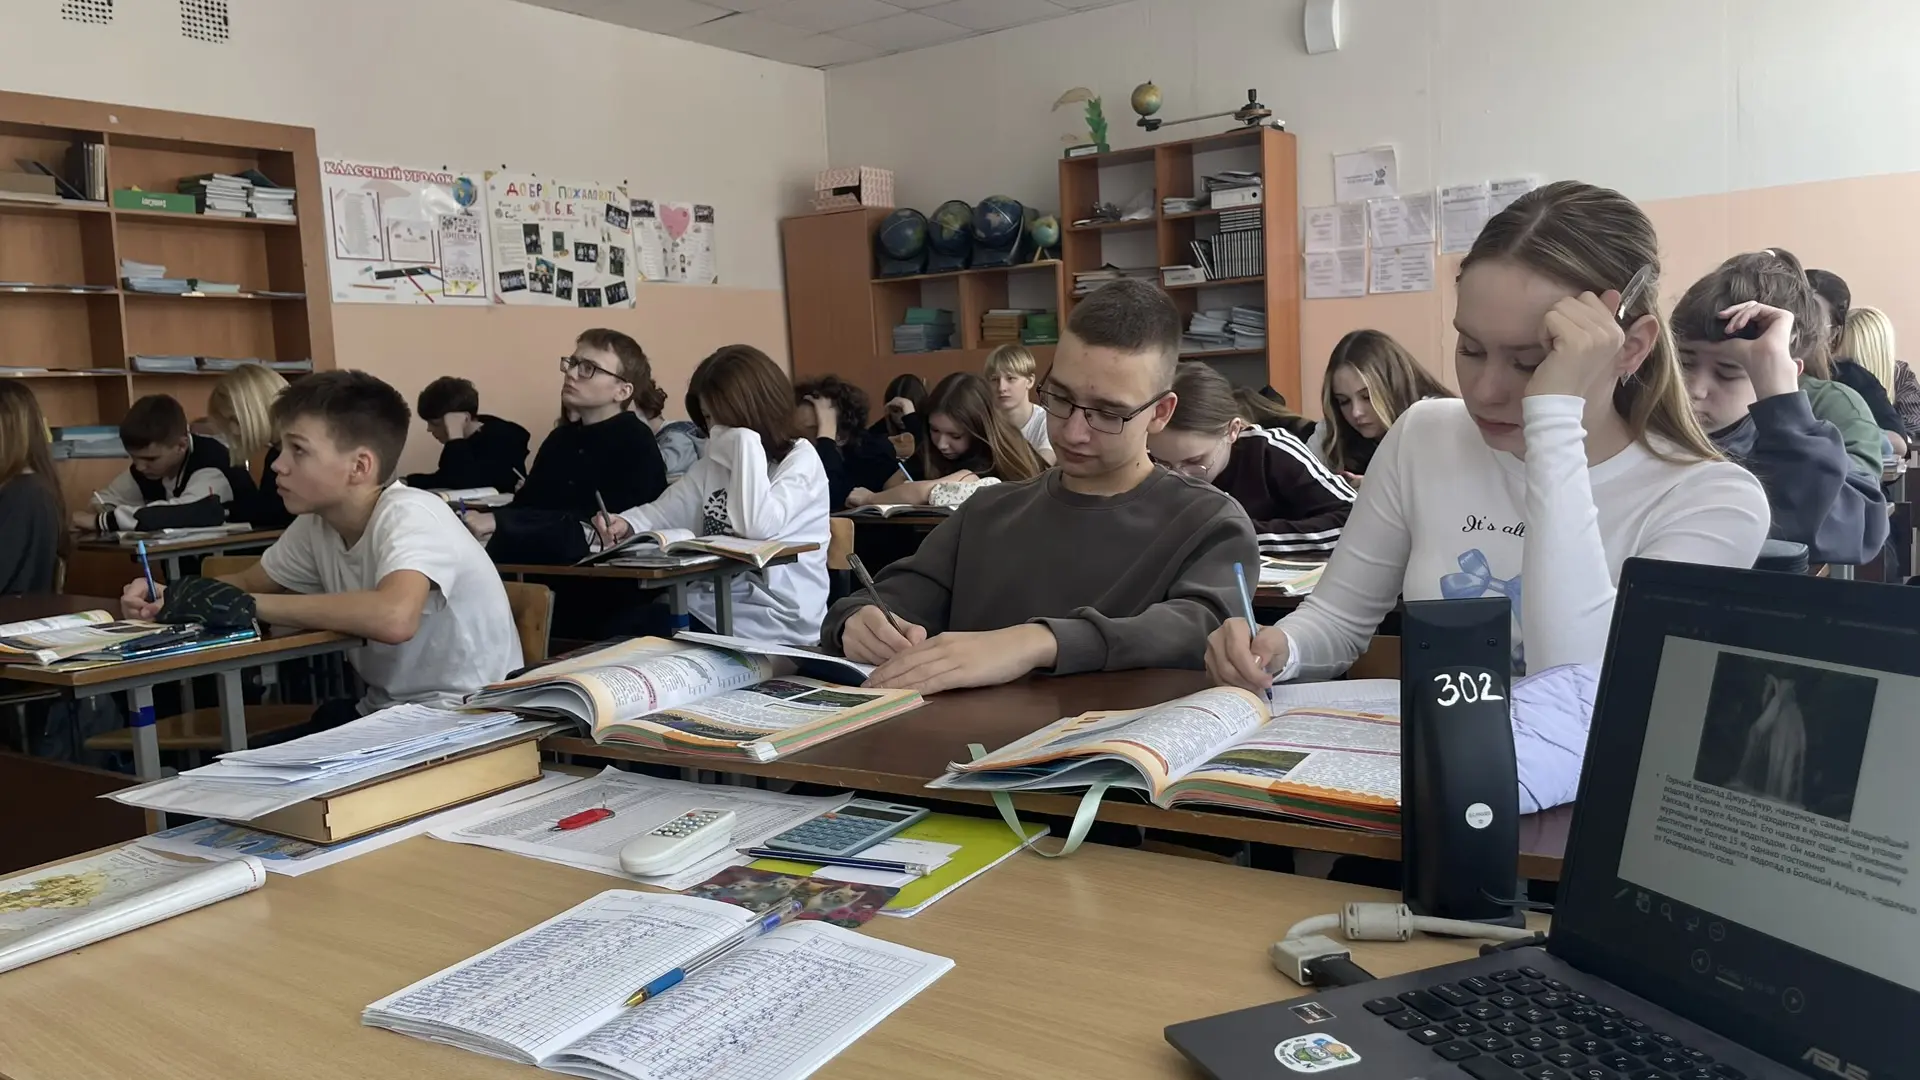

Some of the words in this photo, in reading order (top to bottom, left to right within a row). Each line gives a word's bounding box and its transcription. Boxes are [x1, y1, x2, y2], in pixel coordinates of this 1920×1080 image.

[324, 161, 402, 180] КЛАССНЫЙ
[1462, 515, 1496, 532] It's
[1434, 672, 1504, 706] 302
[1665, 774, 1692, 789] Горный
[1692, 783, 1725, 798] водопад
[1725, 791, 1773, 813] Джур-Джур,
[1775, 808, 1817, 826] наверное,
[1820, 820, 1850, 833] самый
[1695, 793, 1722, 809] Крыма,
[1724, 803, 1758, 818] который
[1758, 814, 1800, 832] находится
[1809, 828, 1870, 851] красивейшем
[1699, 807, 1725, 820] округе
[1760, 823, 1774, 835] Его
[1775, 830, 1816, 846] называют
[1662, 835, 1715, 860] Генеральского
[1693, 827, 1703, 835] не
[1704, 828, 1727, 842] более
[1729, 836, 1738, 845] 15
[1750, 844, 1780, 859] однако
[1781, 854, 1826, 874] постоянно
[1709, 841, 1748, 860] Находится
[1750, 855, 1785, 874] водопад
[1793, 868, 1832, 888] Большой
[1740, 830, 1788, 850] водопадом.
[1790, 844, 1802, 854] Он
[1804, 849, 1854, 873] маленький,
[1801, 1047, 1870, 1080] ASUS
